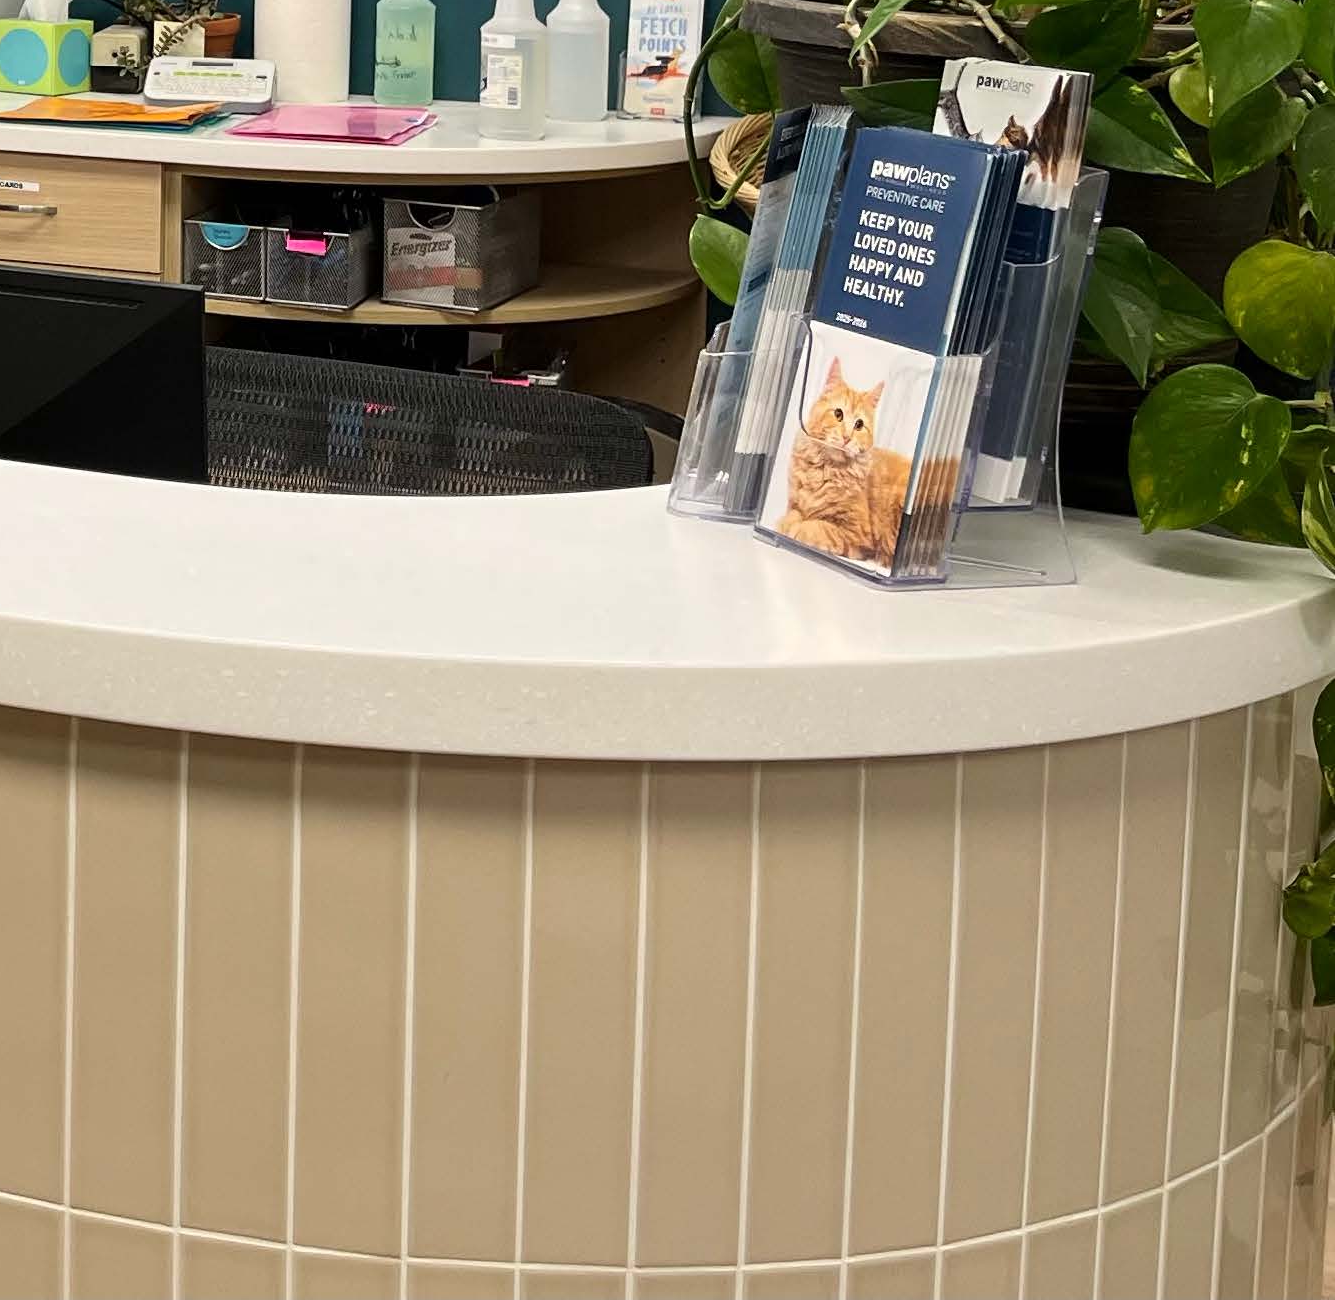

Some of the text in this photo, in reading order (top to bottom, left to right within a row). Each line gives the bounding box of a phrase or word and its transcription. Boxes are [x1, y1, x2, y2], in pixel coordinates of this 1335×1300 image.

[640, 16, 688, 37] FETCH
[639, 37, 687, 53] POINTS
[865, 185, 919, 208] PREVENTIVE
[919, 197, 946, 214] CARE
[859, 209, 934, 241] KEEP YOUR
[390, 238, 452, 257] Energizer
[853, 231, 936, 266] LOVED ONES
[848, 253, 925, 288] HAPPY AND
[843, 275, 905, 308] HEALTHY.
